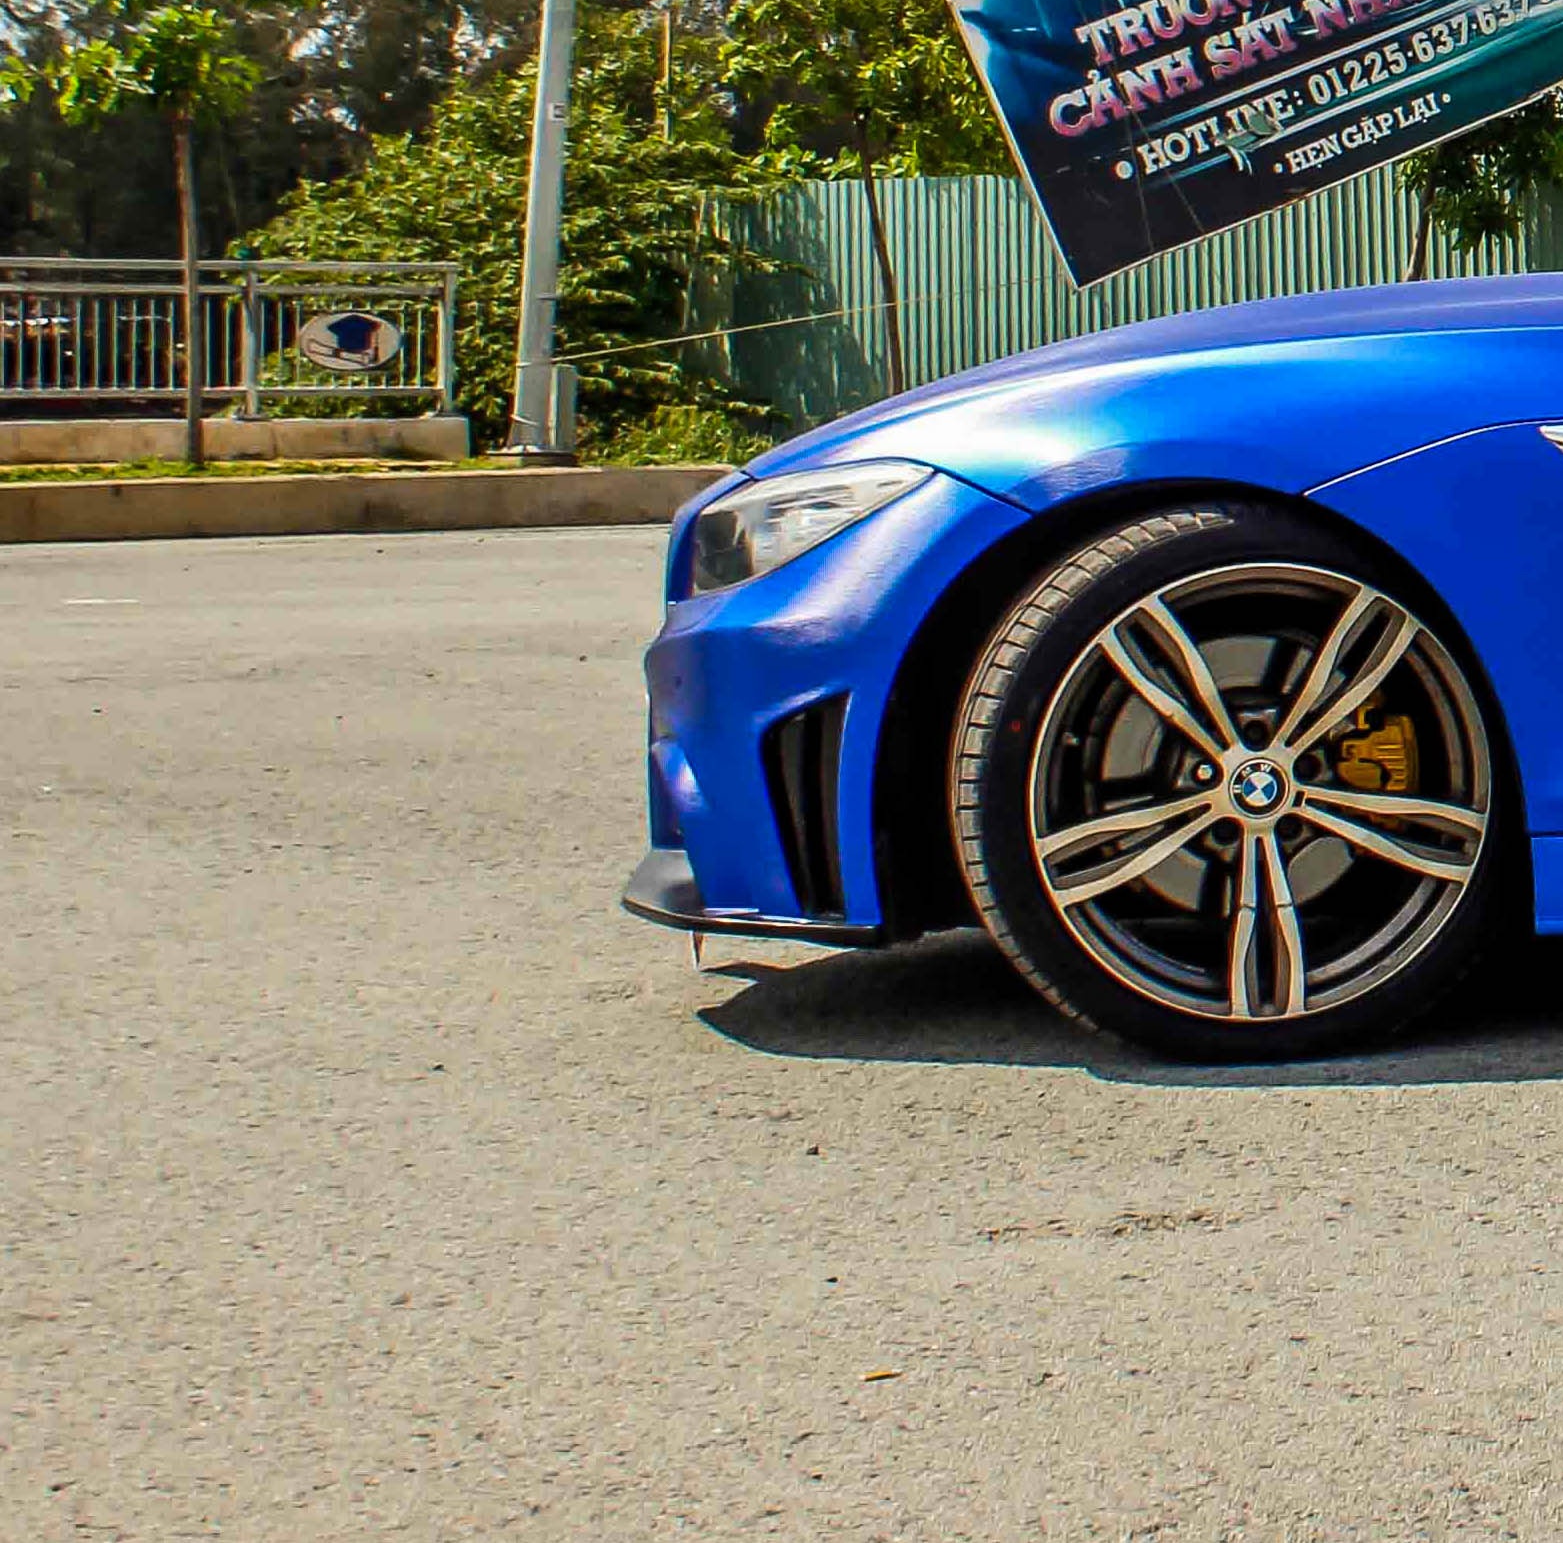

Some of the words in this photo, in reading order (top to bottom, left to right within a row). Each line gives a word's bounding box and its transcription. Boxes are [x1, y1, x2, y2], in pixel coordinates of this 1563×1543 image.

[1049, 47, 1203, 139] CẢNH
[1204, 6, 1298, 82] SÁT
[1136, 88, 1307, 177] HOTLINE:
[1286, 131, 1342, 174] HẸN
[1340, 113, 1396, 149] GẶP
[1393, 91, 1443, 129] LẠI
